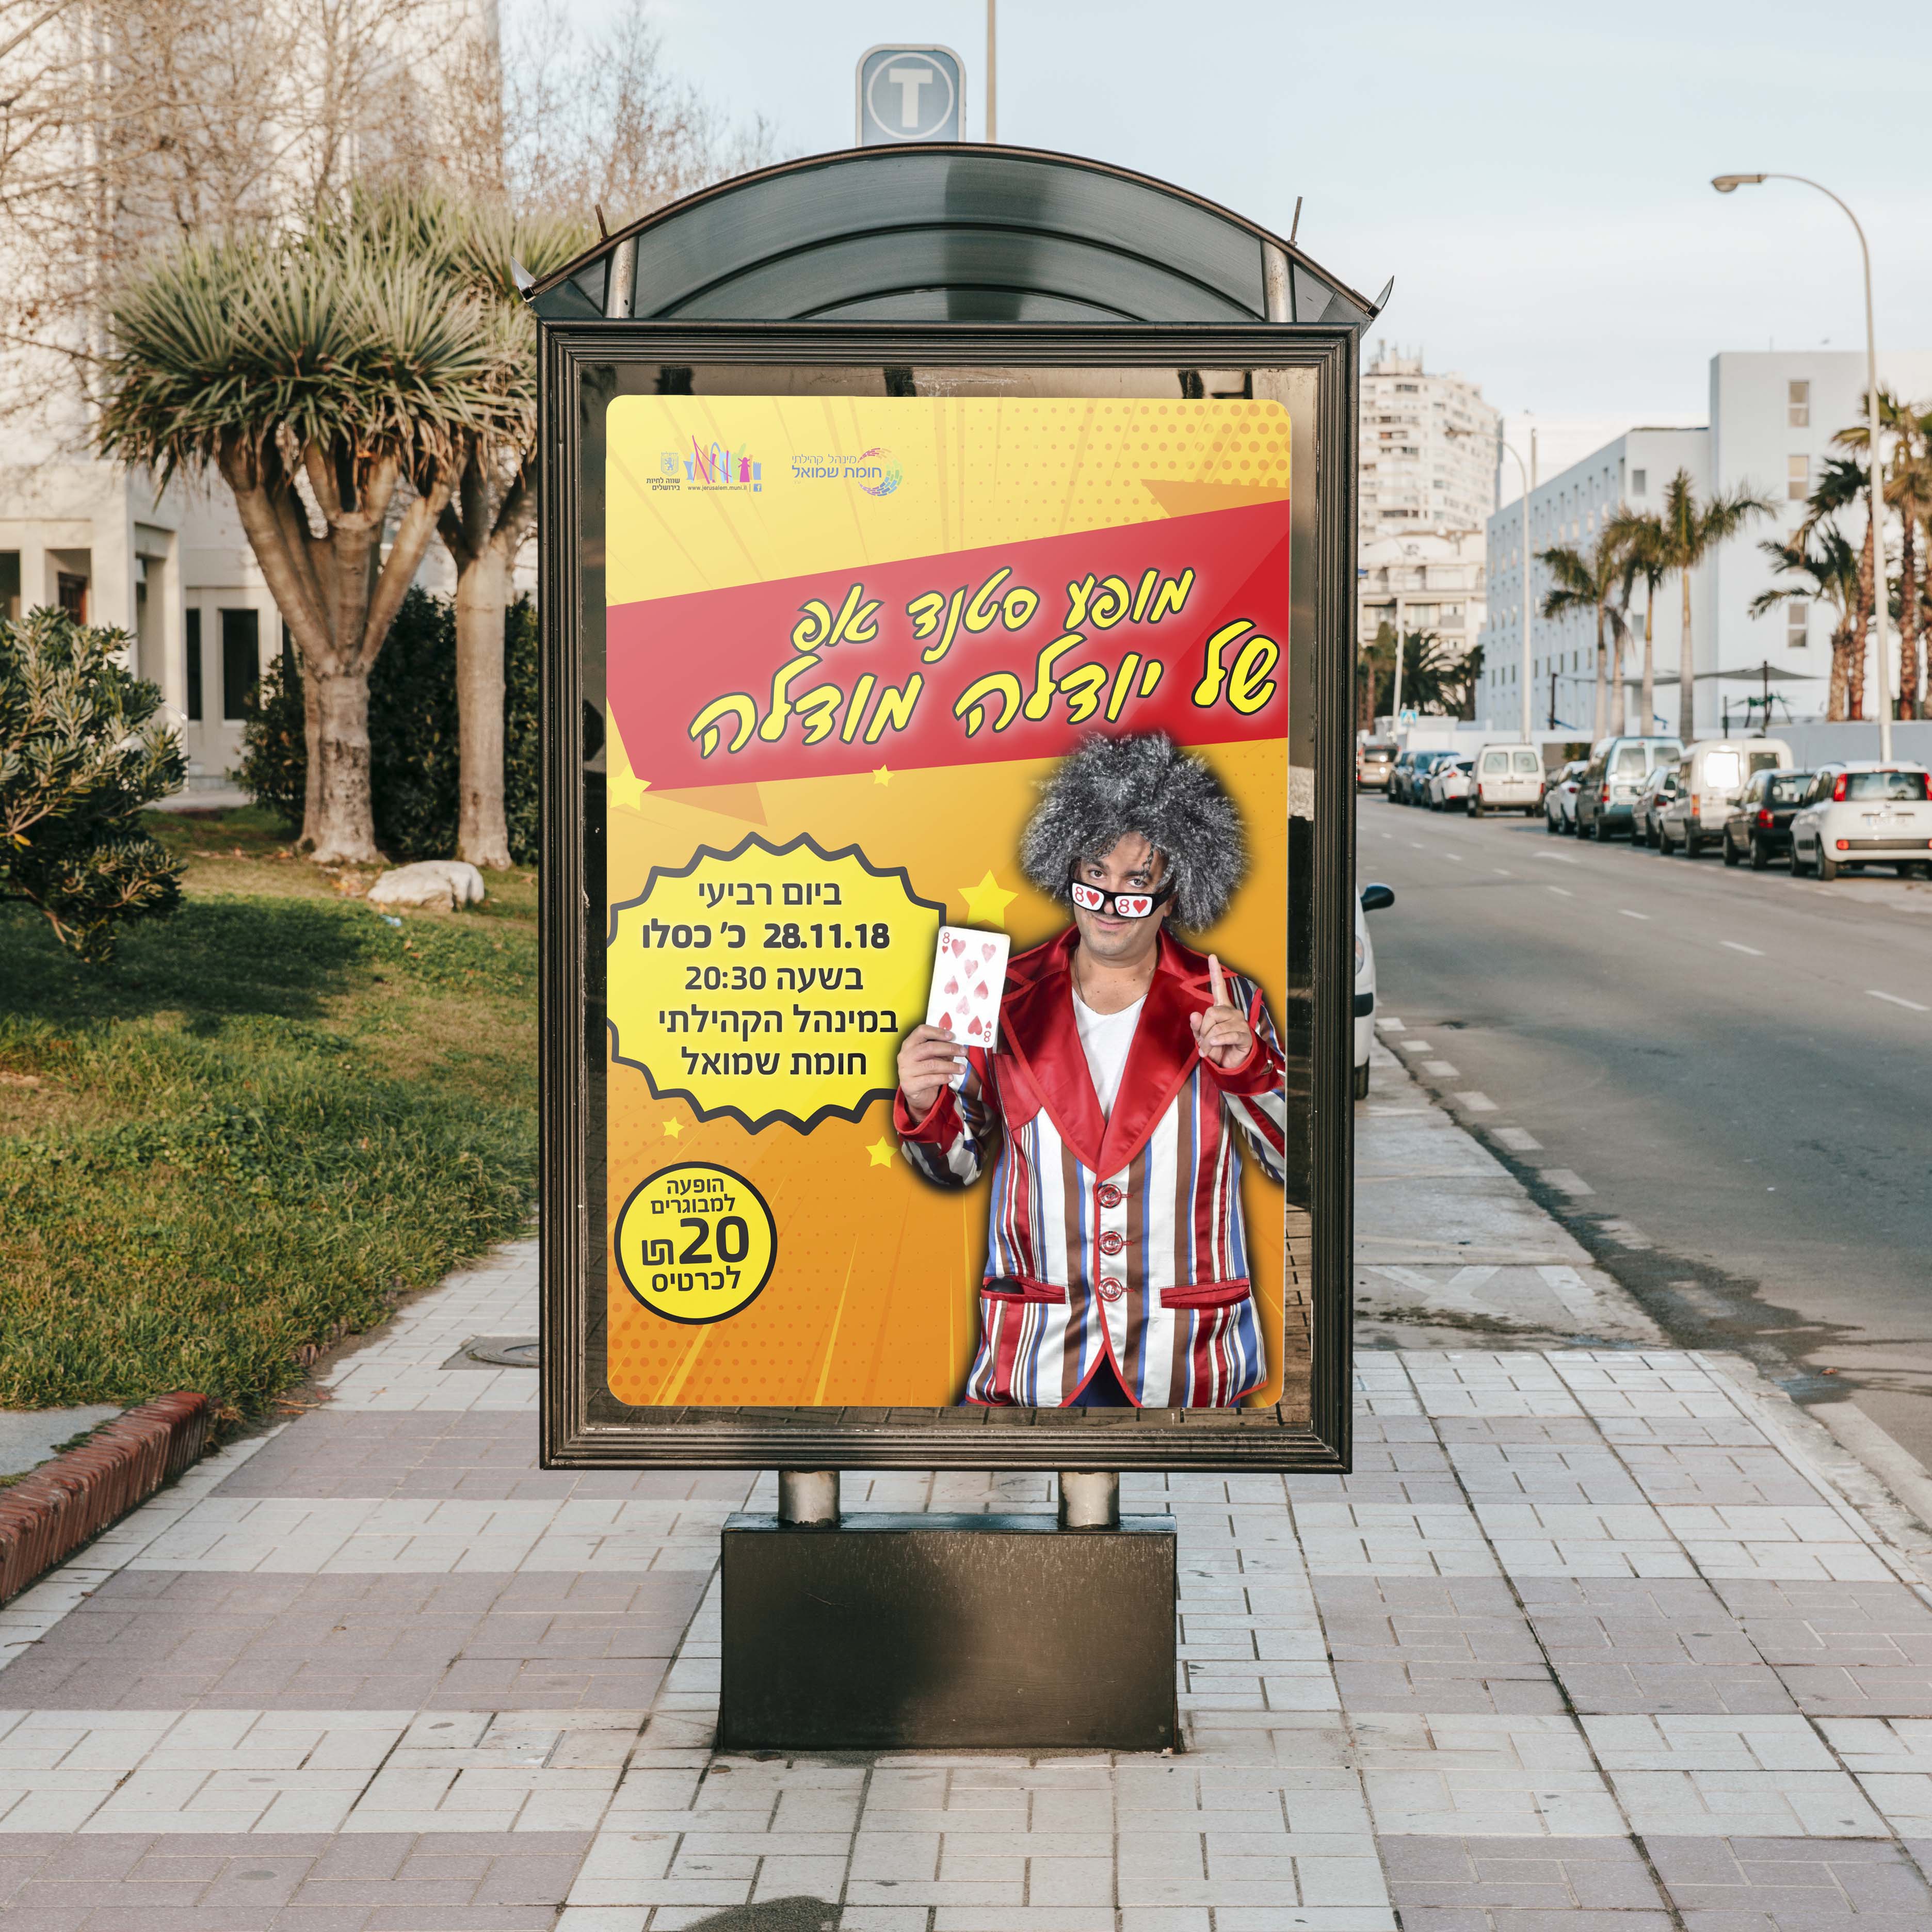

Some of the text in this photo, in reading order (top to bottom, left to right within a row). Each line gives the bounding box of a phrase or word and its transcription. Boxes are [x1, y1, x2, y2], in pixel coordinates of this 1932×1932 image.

[889, 68, 933, 127] T
[792, 454, 857, 465] מינהל קהילתי
[792, 465, 881, 478] חומת שמואל
[791, 566, 1196, 664] מופע סטנד אפ
[688, 618, 1280, 759] של יודלה מודלה
[699, 883, 842, 909] ביום רביעי
[642, 918, 712, 949] כסלו
[763, 923, 890, 949] 28.11.18
[685, 967, 863, 993] בשעה 20:30
[659, 1004, 898, 1042] במינהל הקהילתי
[681, 1046, 866, 1075] חומת שמואל
[667, 1179, 724, 1196] הופעה
[651, 1194, 735, 1214] למבוגרים
[652, 1265, 741, 1292] לכרטיס
